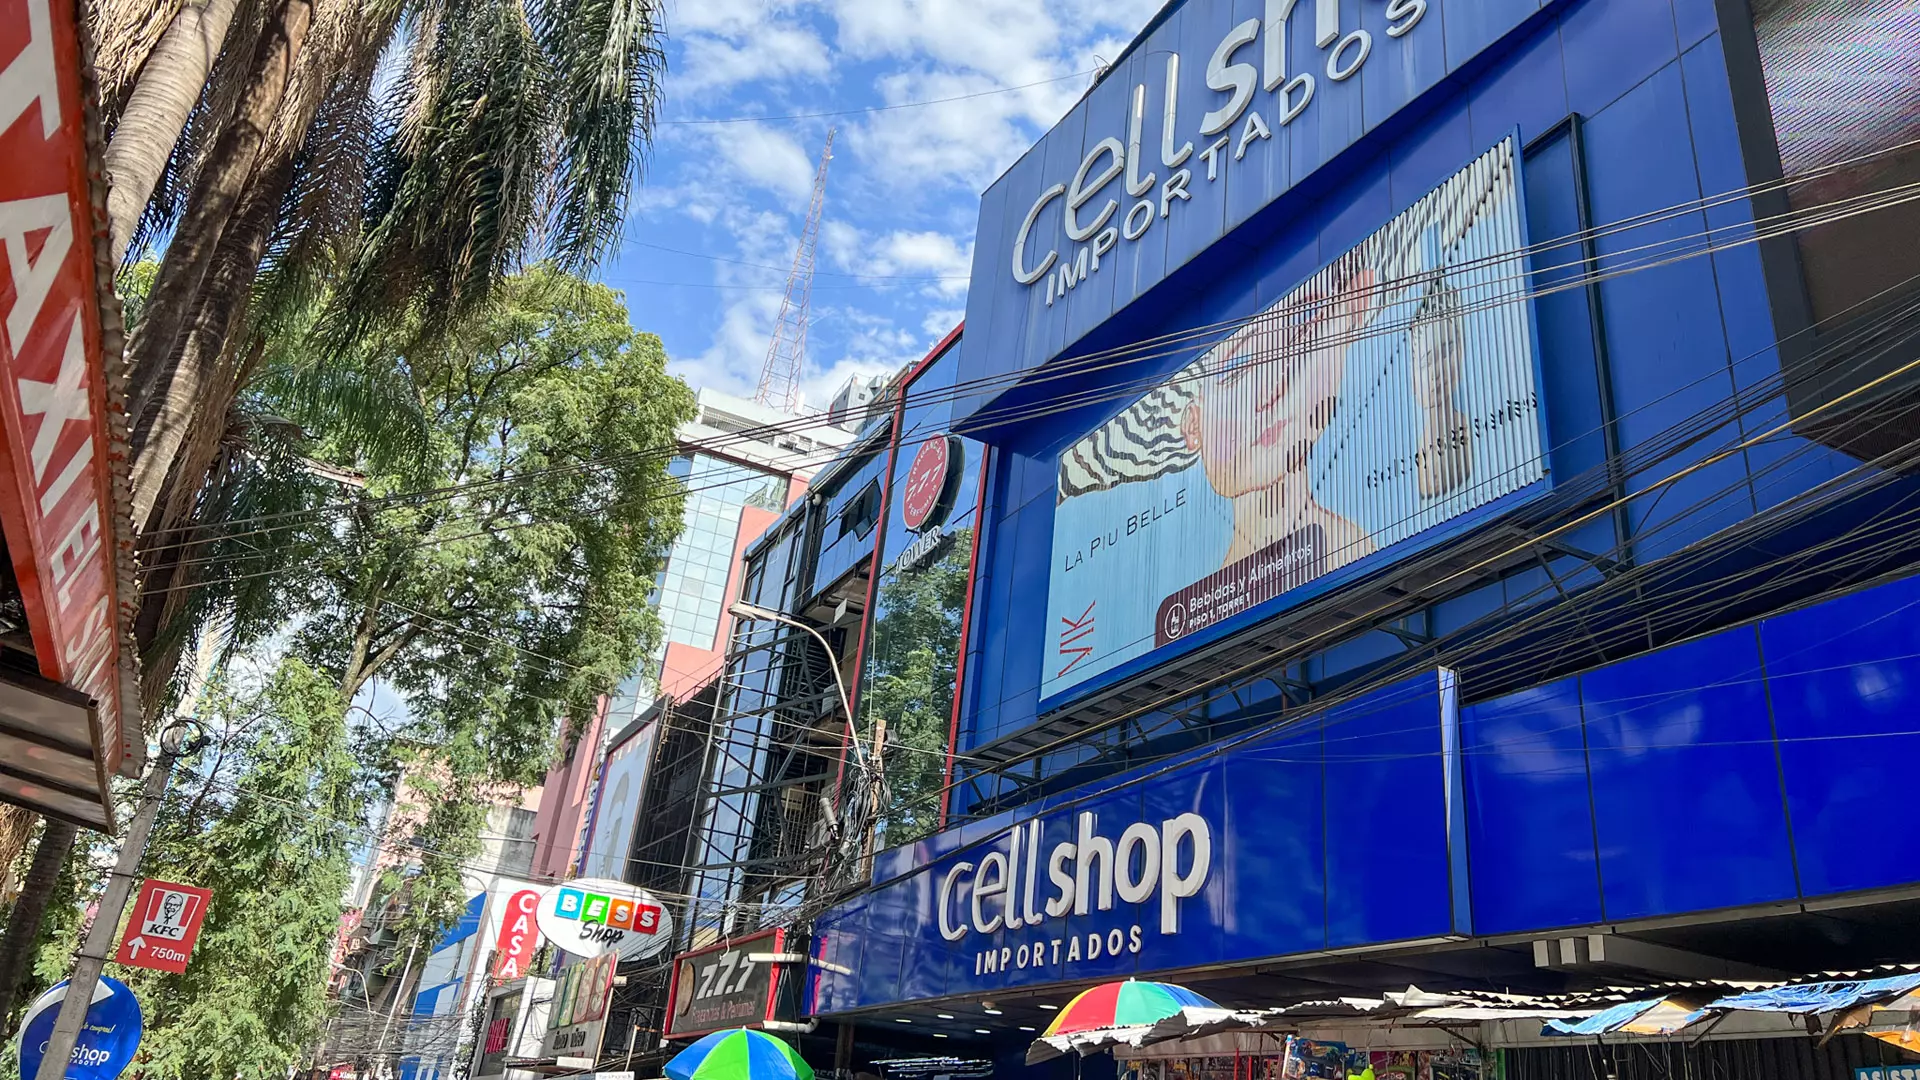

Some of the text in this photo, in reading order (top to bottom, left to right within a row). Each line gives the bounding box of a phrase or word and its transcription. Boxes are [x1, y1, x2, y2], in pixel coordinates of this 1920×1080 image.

[1045, 0, 1427, 307] IMPORTADOS
[895, 525, 941, 573] TOWER
[1065, 488, 1186, 572] LA PIU BELLE
[1189, 581, 1236, 612] Bebidas
[1249, 544, 1312, 584] Alimentos
[1189, 612, 1207, 628] PISO
[1217, 595, 1244, 614] TORRE
[938, 811, 1211, 941] cellshop
[148, 923, 179, 937] KFC
[500, 893, 536, 978] CASA
[561, 893, 655, 929] BESS
[579, 919, 624, 949] Shop
[150, 946, 186, 963] 750m
[975, 924, 1143, 976] IMPORTADOS
